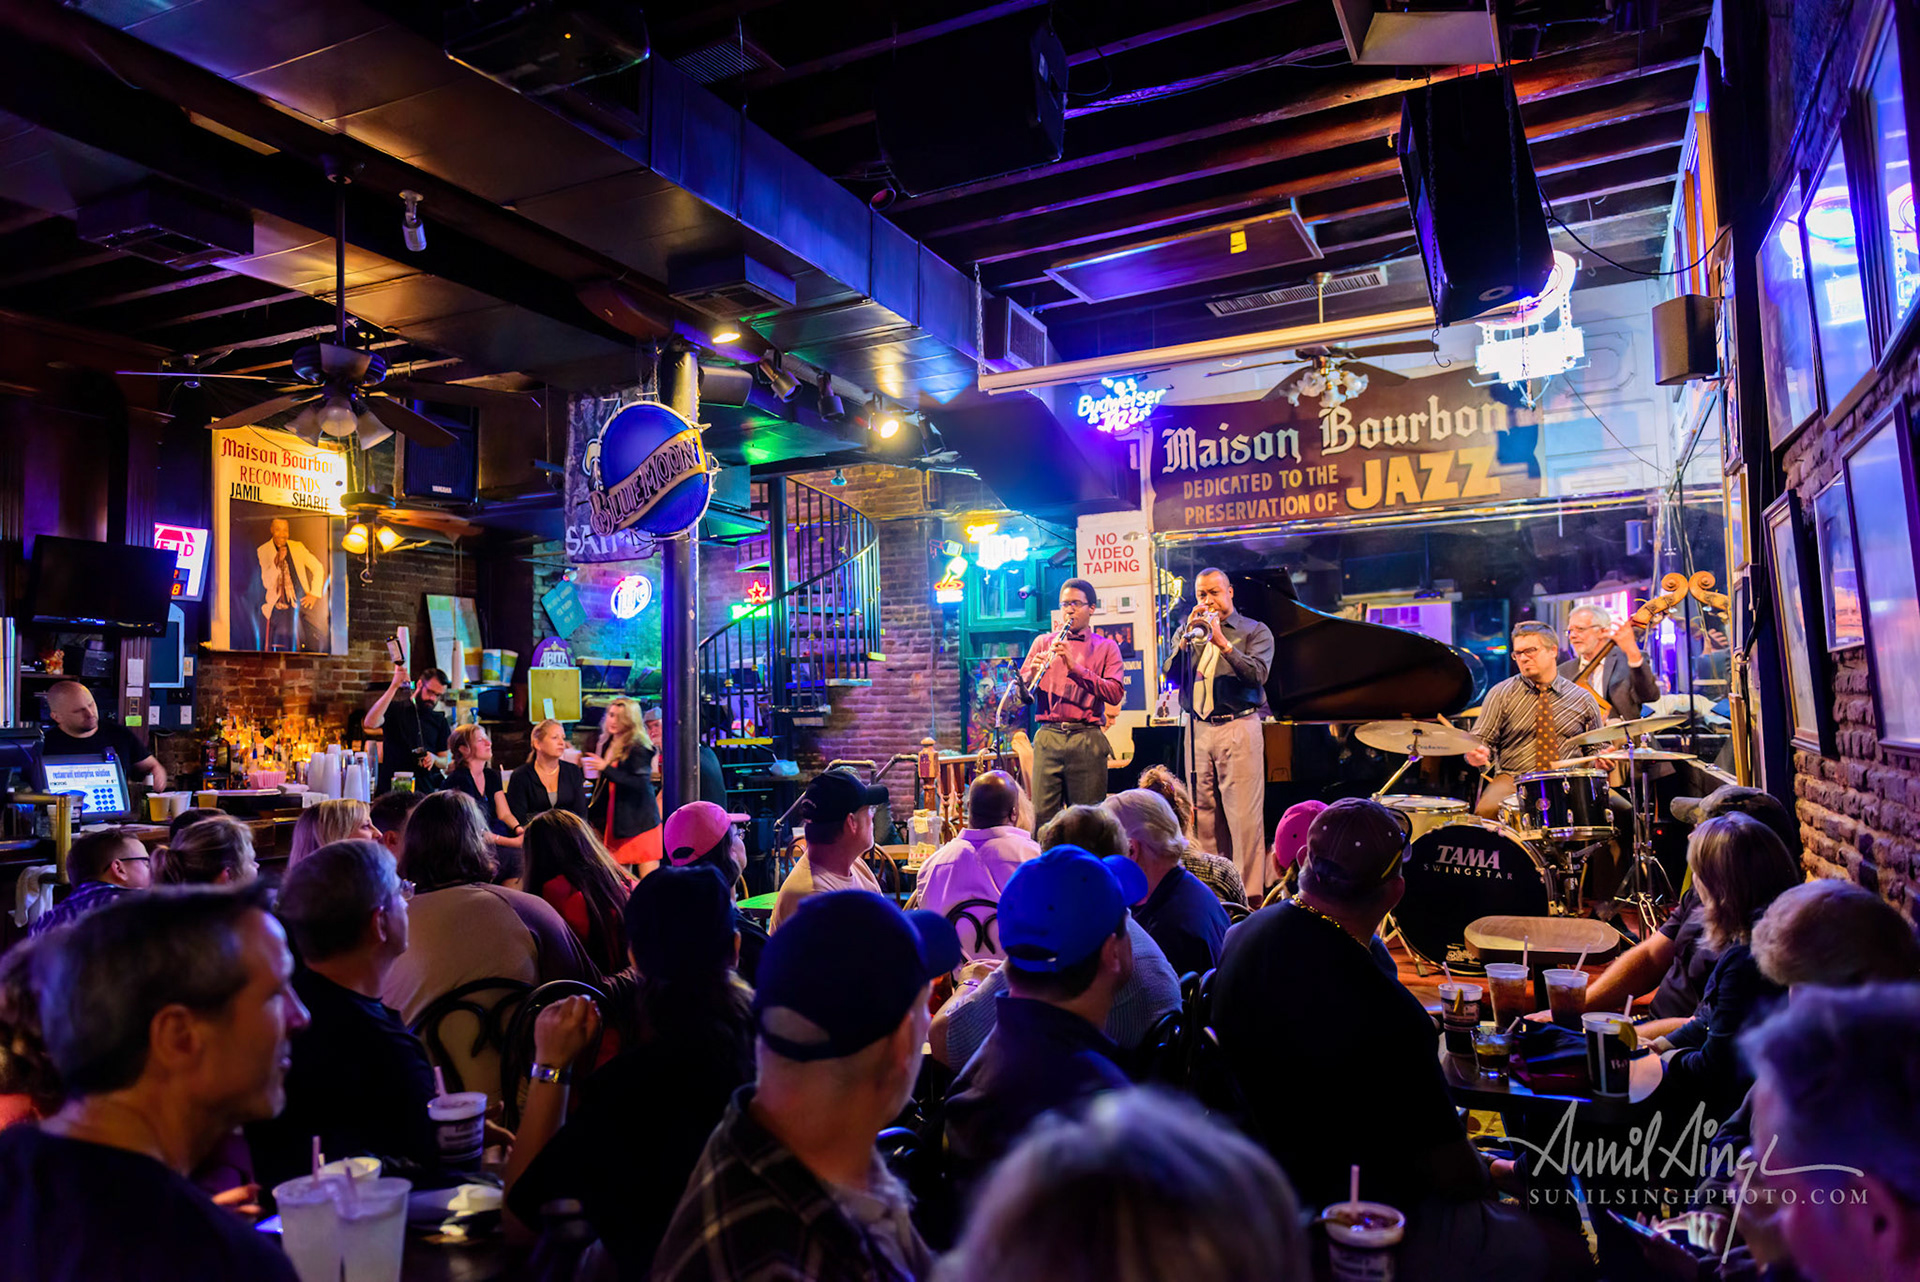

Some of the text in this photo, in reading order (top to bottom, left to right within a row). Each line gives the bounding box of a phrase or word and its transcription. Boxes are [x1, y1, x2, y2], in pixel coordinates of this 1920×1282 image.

[1078, 389, 1167, 417] Budweiser
[1162, 395, 1510, 474] Maison Bourbon
[221, 436, 278, 466] Maison
[240, 466, 321, 494] RECOMMENDS
[1184, 464, 1339, 500] DEDICATED TO THE
[1346, 445, 1501, 510] JAZZ
[230, 482, 263, 502] JAMIL
[1185, 492, 1338, 525] PRESERVATION OF
[1087, 545, 1134, 560] VIDEO
[1095, 532, 1118, 546] NO
[1083, 559, 1140, 575] TAPING
[1423, 863, 1513, 880] SWINGSTAR
[1435, 845, 1500, 870] TAMA
